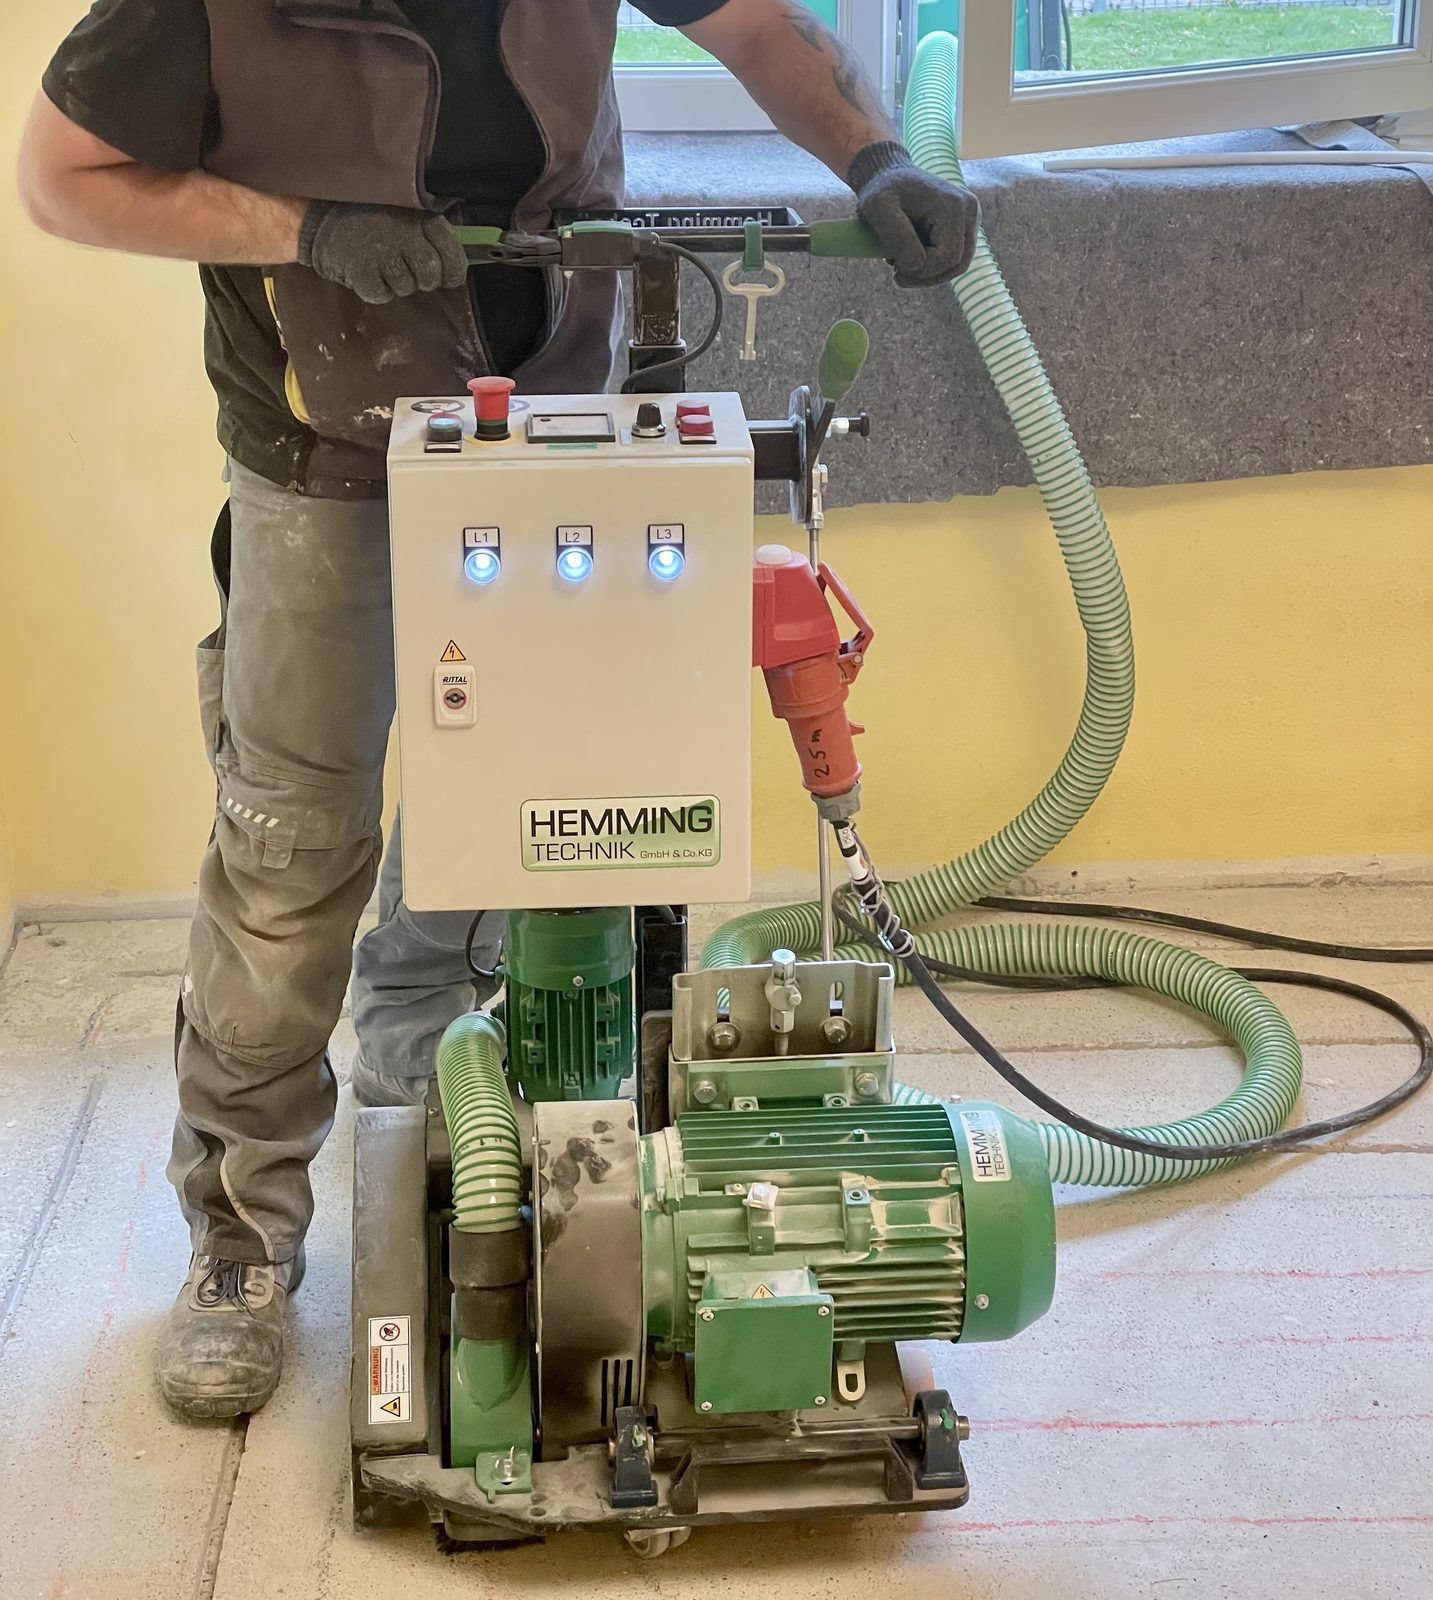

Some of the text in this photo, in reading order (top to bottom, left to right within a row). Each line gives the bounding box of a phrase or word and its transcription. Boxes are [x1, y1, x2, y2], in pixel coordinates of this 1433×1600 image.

[474, 532, 489, 543] L1
[565, 532, 580, 543] L2
[656, 529, 672, 540] L3
[530, 805, 712, 838] HEMMING
[531, 841, 635, 861] TECHNIK
[640, 850, 670, 859] GmbH
[672, 849, 680, 858] &
[964, 1112, 993, 1177] HEMMING
[988, 1133, 1006, 1176] TECHNIK
